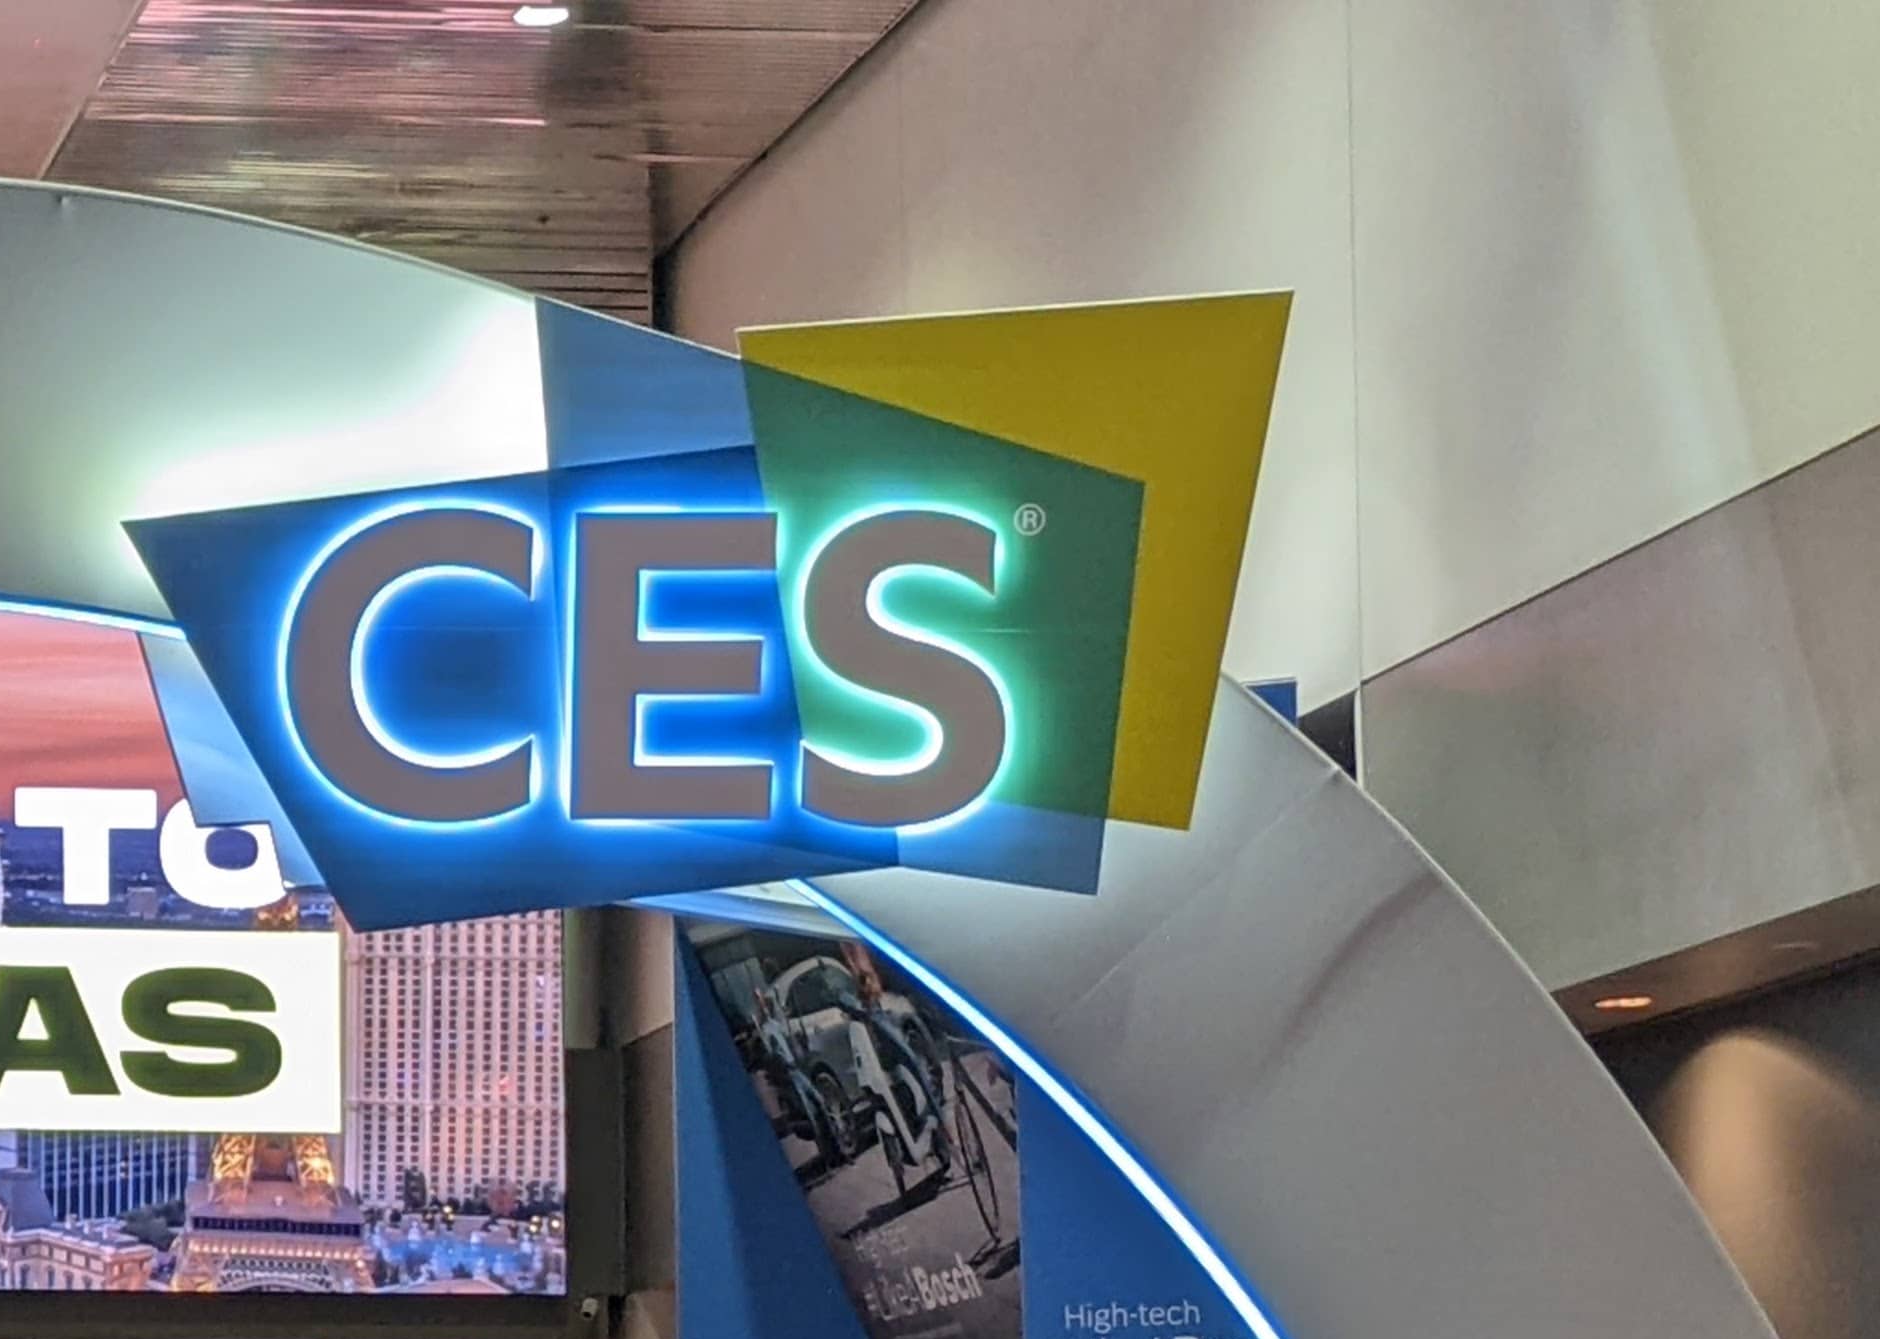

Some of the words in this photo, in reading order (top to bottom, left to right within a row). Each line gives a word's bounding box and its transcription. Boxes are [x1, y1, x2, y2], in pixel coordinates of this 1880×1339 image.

[286, 505, 1010, 828] CES
[9, 786, 298, 911] TO
[1064, 1300, 1200, 1334] High-tech
